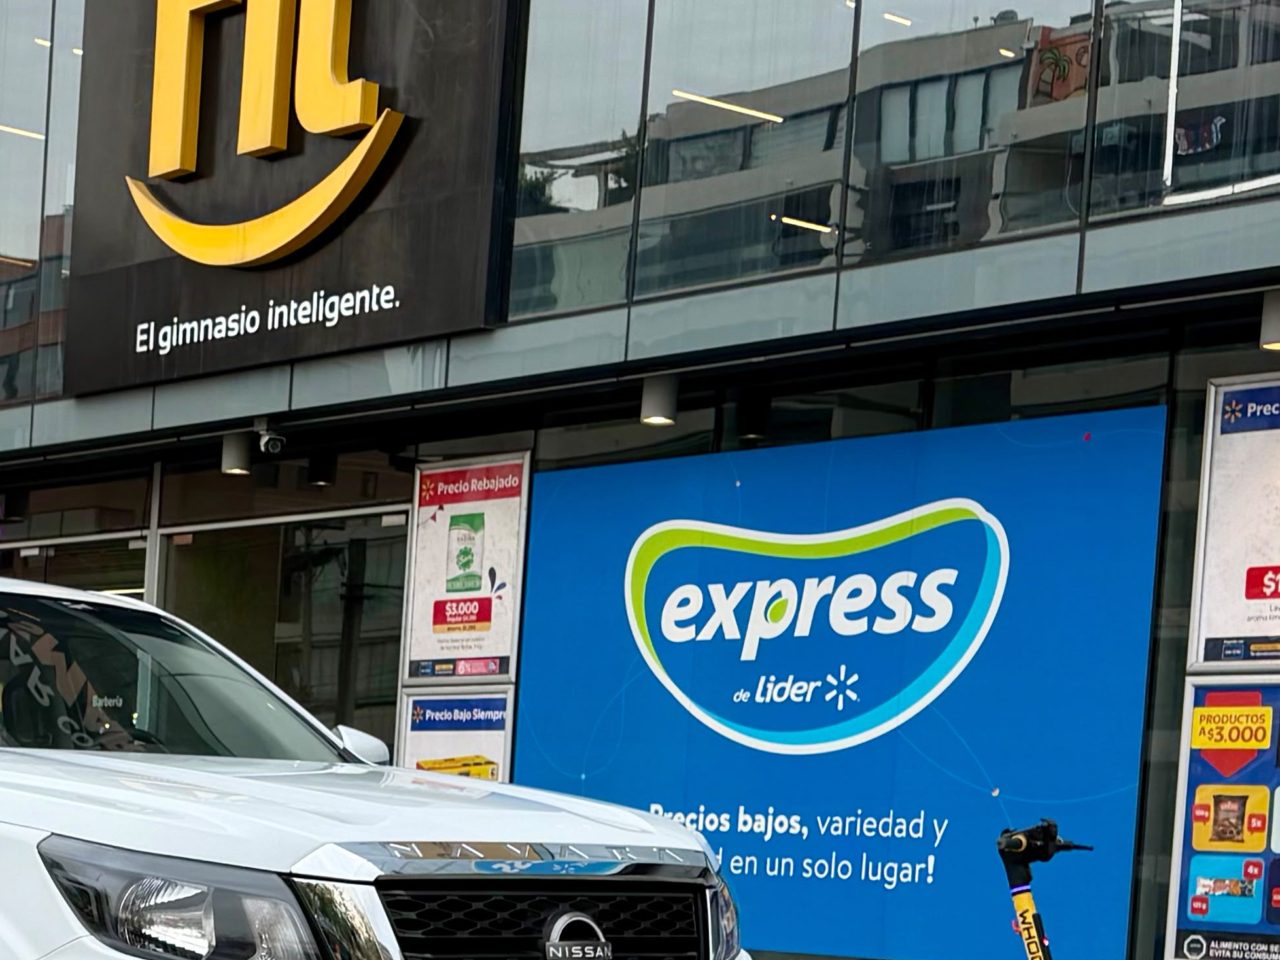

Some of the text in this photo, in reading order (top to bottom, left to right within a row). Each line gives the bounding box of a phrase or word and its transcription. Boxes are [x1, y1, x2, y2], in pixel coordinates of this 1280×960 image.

[136, 283, 401, 356] El gimnasio inteligente.
[437, 473, 520, 496] Precio Rebajado
[445, 602, 479, 616] $3.000
[660, 568, 959, 661] express
[733, 688, 751, 702] de
[425, 709, 452, 721] Precio
[453, 708, 472, 723] Bajo
[1199, 714, 1266, 725] PRODUCTOS
[650, 803, 949, 848] Pecios bajos, variedad y
[730, 856, 758, 876] en
[766, 856, 794, 877] un
[802, 852, 852, 880] solo
[861, 853, 935, 890] lugar!
[549, 945, 613, 959] NISSAN
[1210, 940, 1249, 951] ALIMENTO
[1244, 951, 1280, 960] CONSUM
